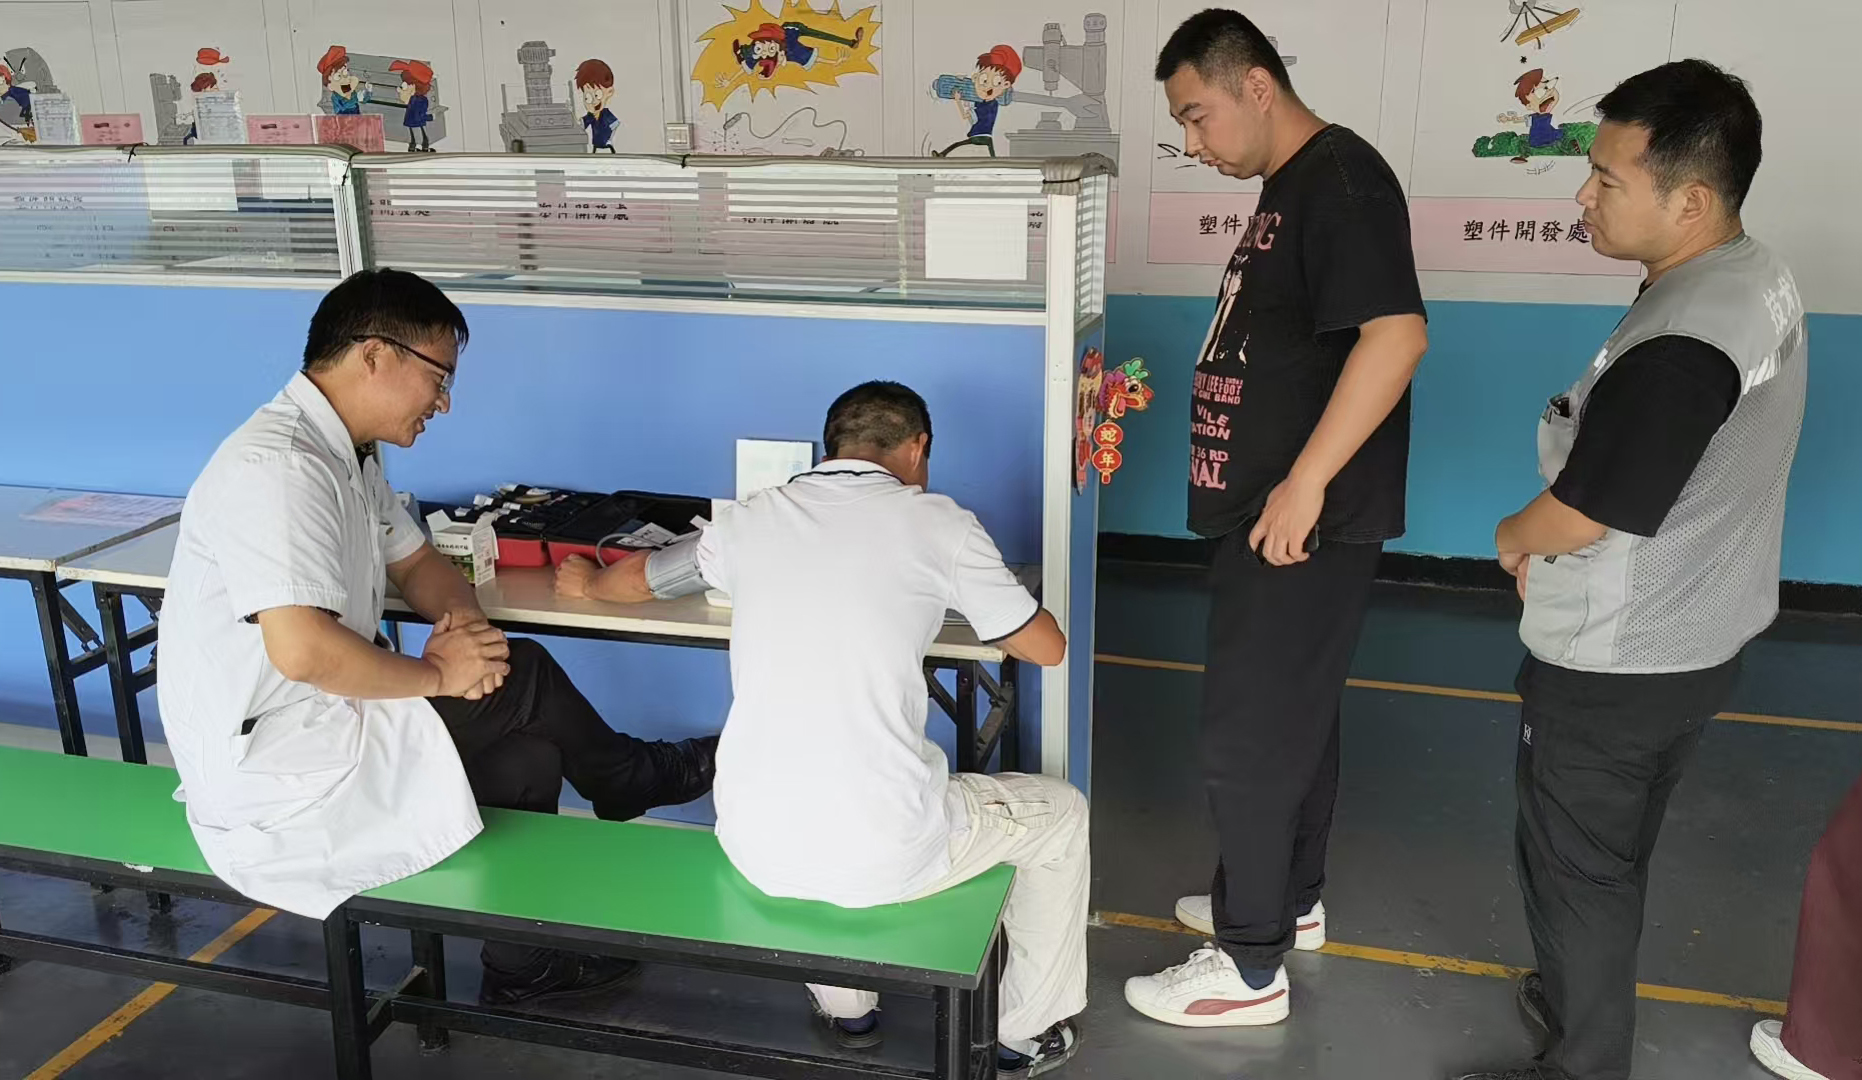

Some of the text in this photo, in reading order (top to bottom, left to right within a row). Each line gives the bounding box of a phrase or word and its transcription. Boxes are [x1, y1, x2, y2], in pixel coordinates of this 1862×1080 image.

[1463, 218, 1590, 243] 塑件開發處
[1214, 393, 1241, 405] BAND
